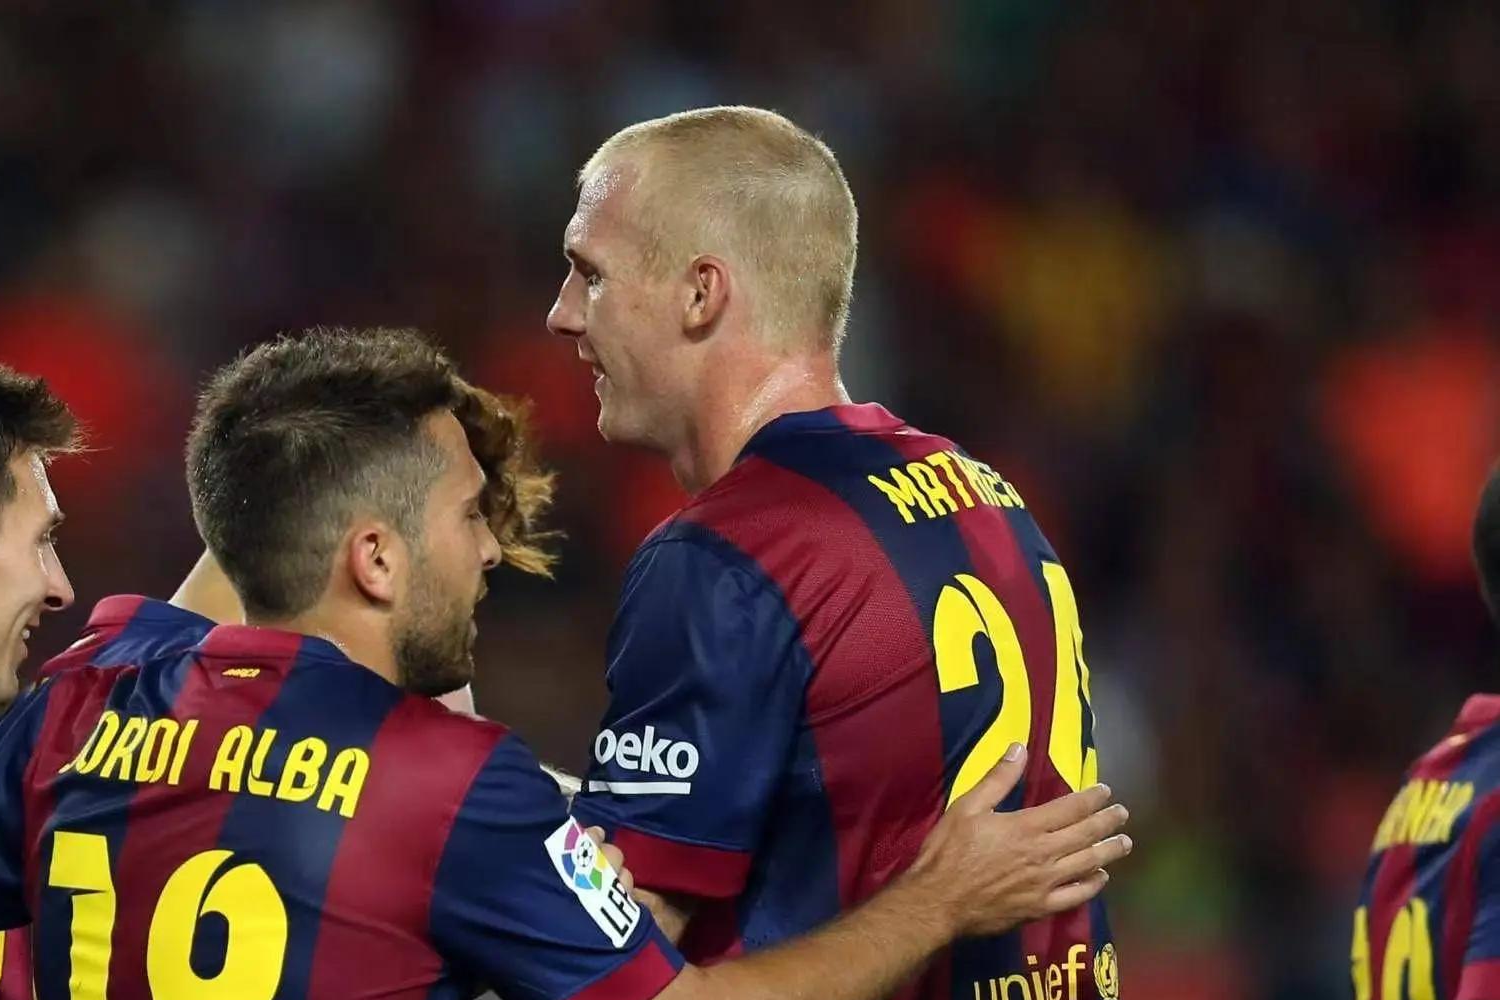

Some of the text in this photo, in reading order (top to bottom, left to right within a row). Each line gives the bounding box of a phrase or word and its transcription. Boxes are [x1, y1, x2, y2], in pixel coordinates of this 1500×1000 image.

[933, 560, 1099, 808] 24
[209, 715, 370, 818] ALBA
[600, 877, 637, 938] LFP
